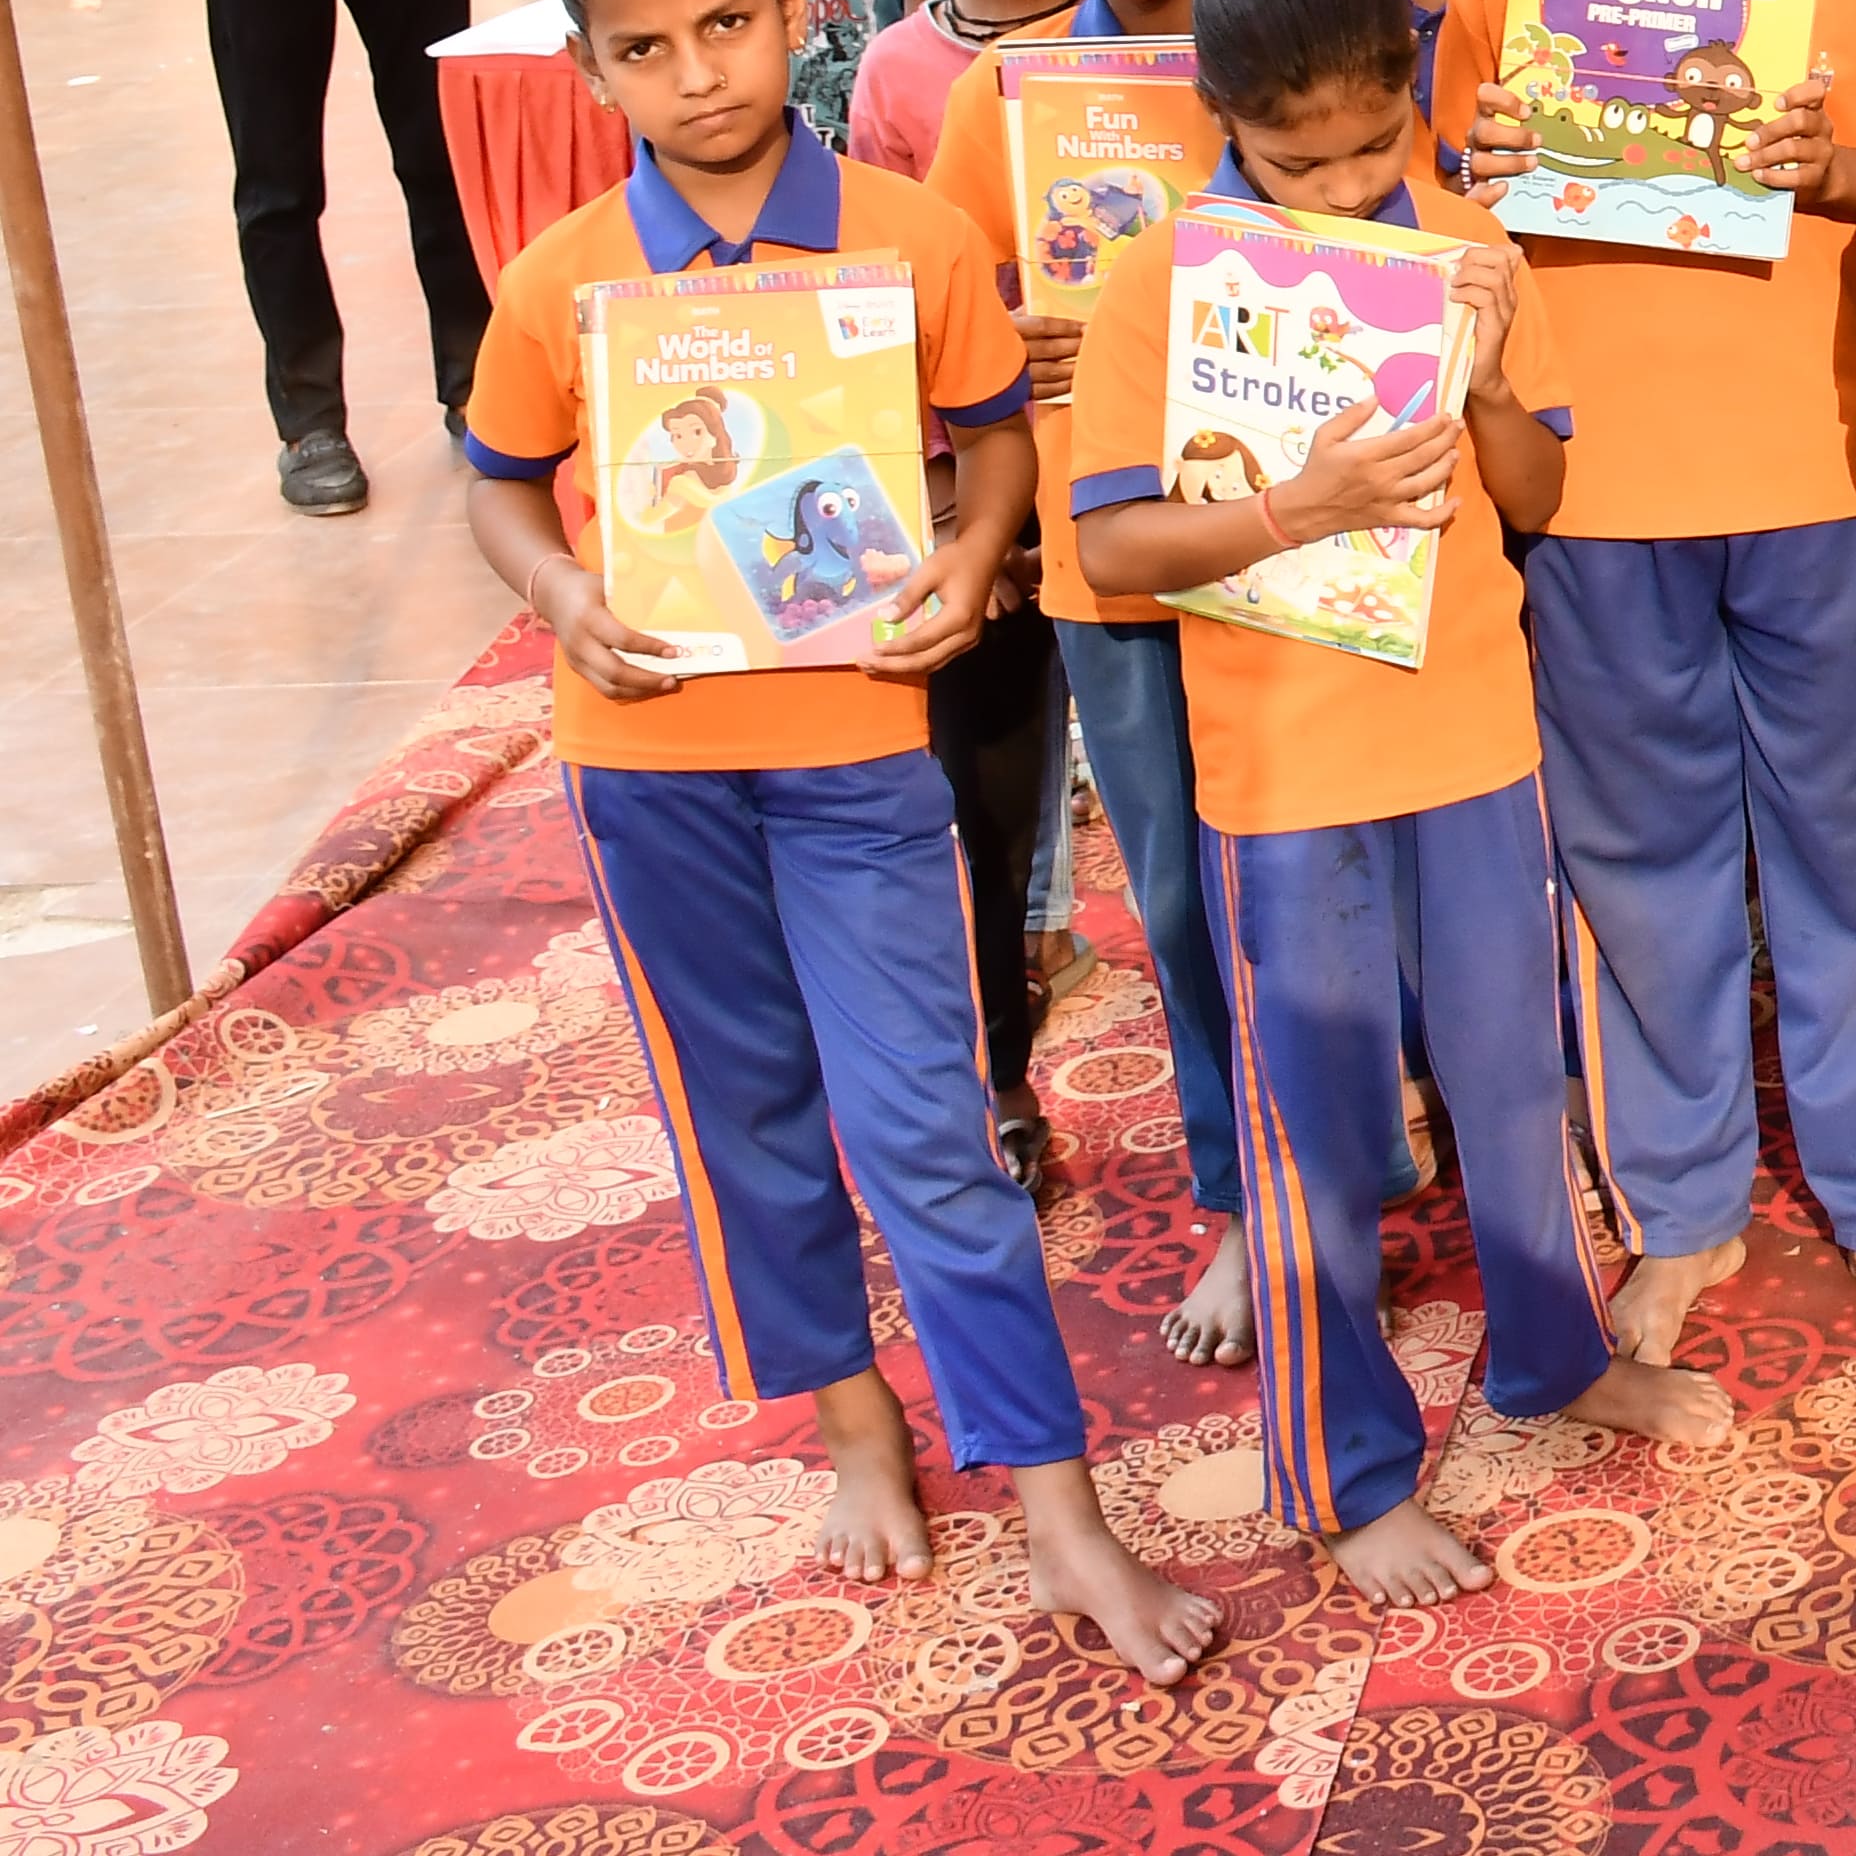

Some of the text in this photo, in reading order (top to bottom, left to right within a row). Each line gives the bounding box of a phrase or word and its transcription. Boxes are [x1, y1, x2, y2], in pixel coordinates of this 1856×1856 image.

[1586, 1, 1698, 35] PRE-PRIMER
[1085, 105, 1139, 131] Fun
[1057, 135, 1185, 162] Numbers
[1089, 128, 1121, 142] With
[658, 328, 752, 361] World
[693, 324, 719, 339] The
[1192, 300, 1291, 366] ART
[635, 352, 798, 386] Numbers 1
[1191, 356, 1357, 418] Strokes
